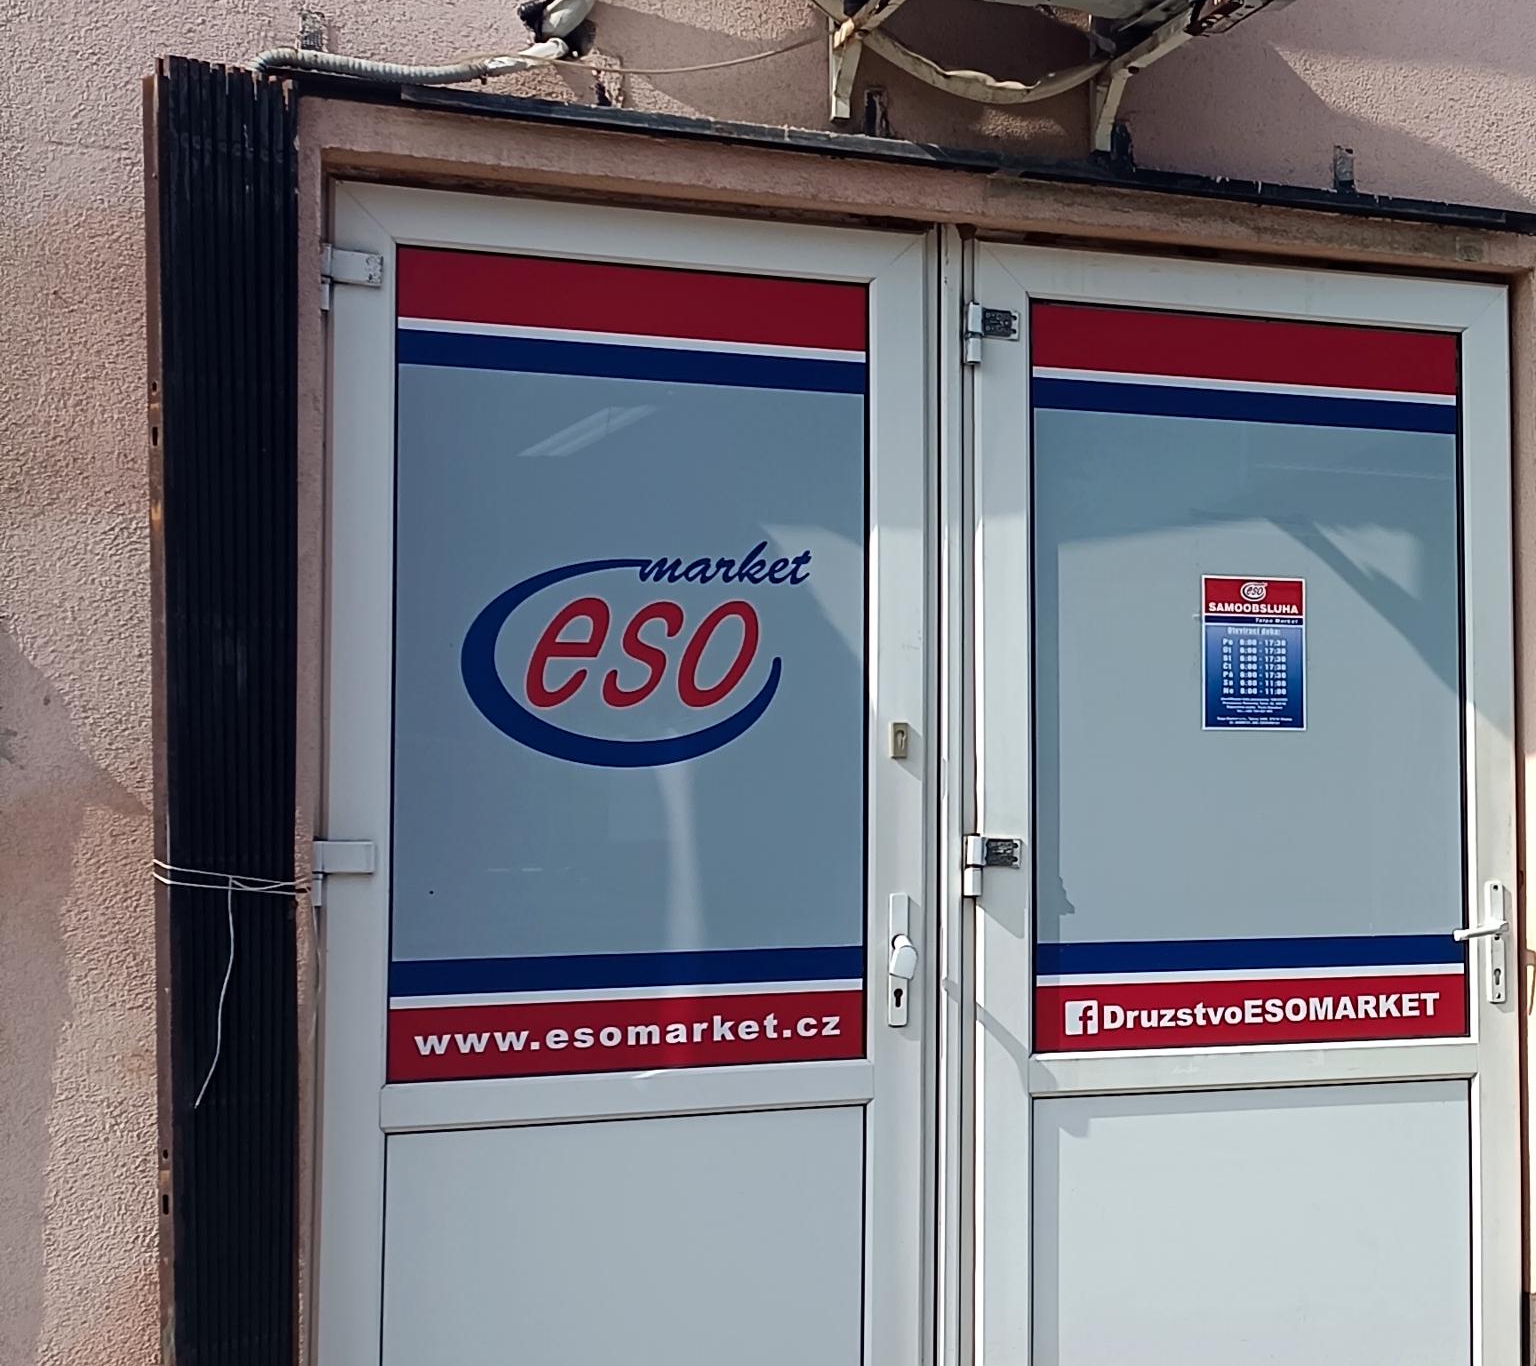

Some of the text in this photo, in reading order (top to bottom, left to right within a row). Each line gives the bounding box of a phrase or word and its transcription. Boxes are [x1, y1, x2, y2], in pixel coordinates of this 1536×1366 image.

[639, 541, 810, 587] market
[1208, 601, 1299, 614] SAMOOBSLUHA
[1246, 586, 1264, 596] eso
[525, 596, 759, 709] eso
[1103, 992, 1440, 1031] DruzstvoESOMARKET
[414, 1013, 842, 1056] www.esomarket.cz
